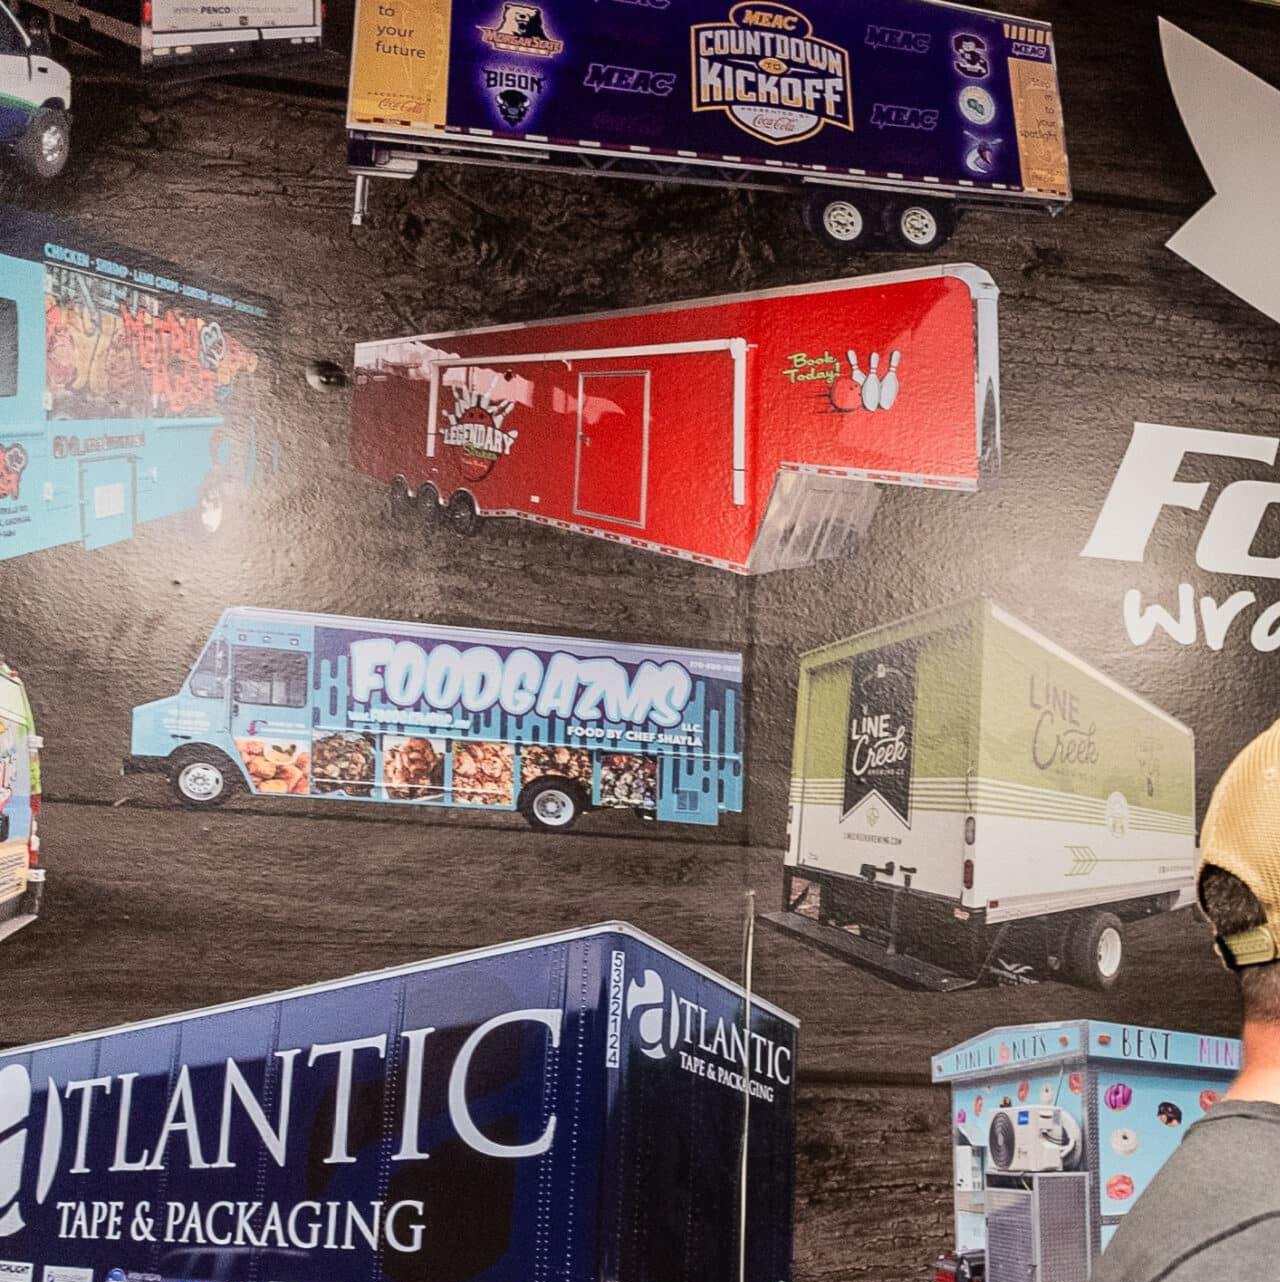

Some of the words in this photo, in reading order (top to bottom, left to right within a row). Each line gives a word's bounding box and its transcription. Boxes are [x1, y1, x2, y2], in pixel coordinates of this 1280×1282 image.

[378, 5, 395, 17] to
[742, 9, 799, 31] MEAC
[376, 23, 415, 38] your
[865, 25, 932, 54] MEAC
[375, 41, 427, 59] future
[700, 29, 843, 77] COUNTDOWN
[485, 69, 546, 93] BISON
[584, 63, 677, 97] MEAC
[700, 57, 844, 117] KICKOFF
[870, 103, 940, 131] MEAC
[783, 363, 841, 384] Today!
[787, 350, 840, 367] Book
[443, 422, 516, 455] LEGENDARY
[350, 637, 692, 728] FOODGAZMS
[1029, 671, 1081, 727] LINE
[567, 725, 604, 739] FOOD
[606, 727, 622, 741] BY
[625, 730, 656, 743] CHEF
[657, 733, 703, 748] SHAYLA
[851, 713, 892, 741] LINE
[1032, 709, 1099, 771] Creek
[852, 725, 908, 777] Creek
[1121, 1027, 1172, 1061] BEST
[679, 1050, 706, 1076] TAPE
[706, 1063, 717, 1081] &
[718, 1066, 775, 1103] PACKAGING
[57, 1200, 124, 1241] TAPE
[130, 1200, 157, 1242] &
[164, 1199, 427, 1253] PACKAGING
